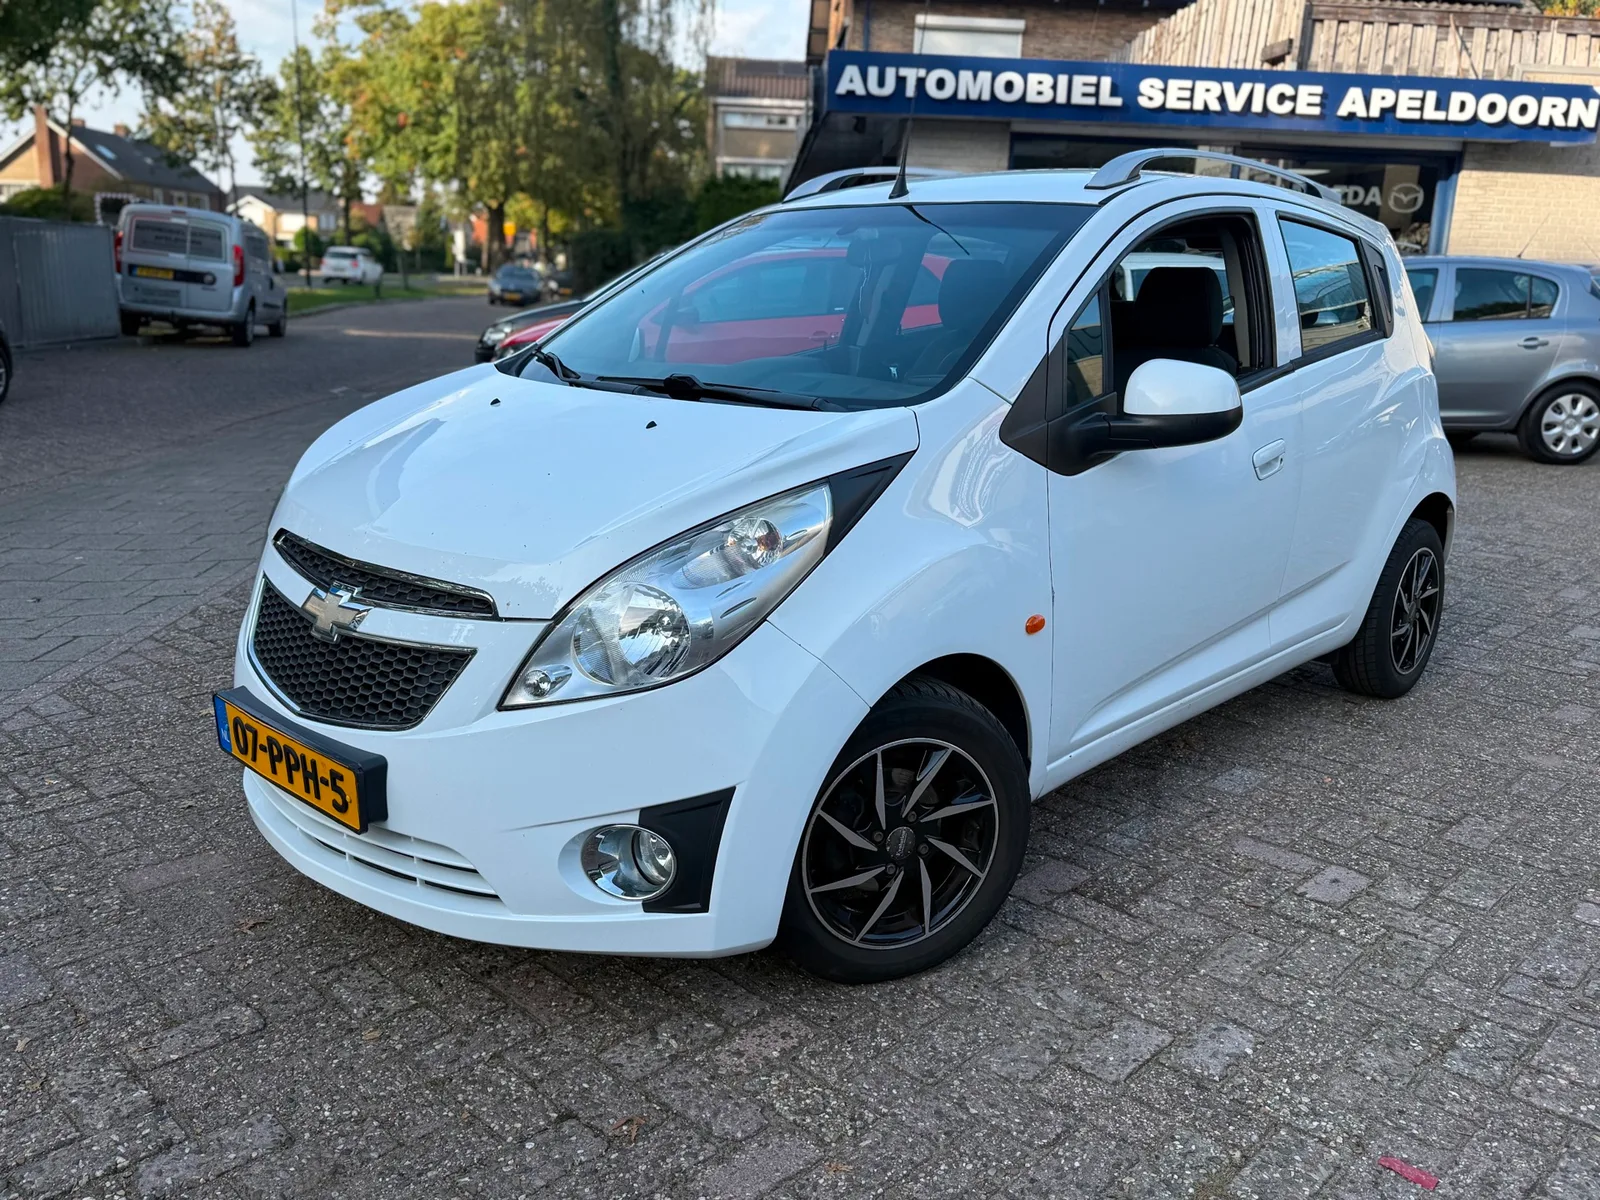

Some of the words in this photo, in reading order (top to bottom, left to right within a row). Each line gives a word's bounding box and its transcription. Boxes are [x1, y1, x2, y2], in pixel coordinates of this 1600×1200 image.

[835, 64, 1123, 107] AUTOMOBIEL
[1137, 77, 1324, 116] SERVICE
[1336, 86, 1600, 128] APELDOORN
[232, 716, 349, 814] 07-PPH-5
